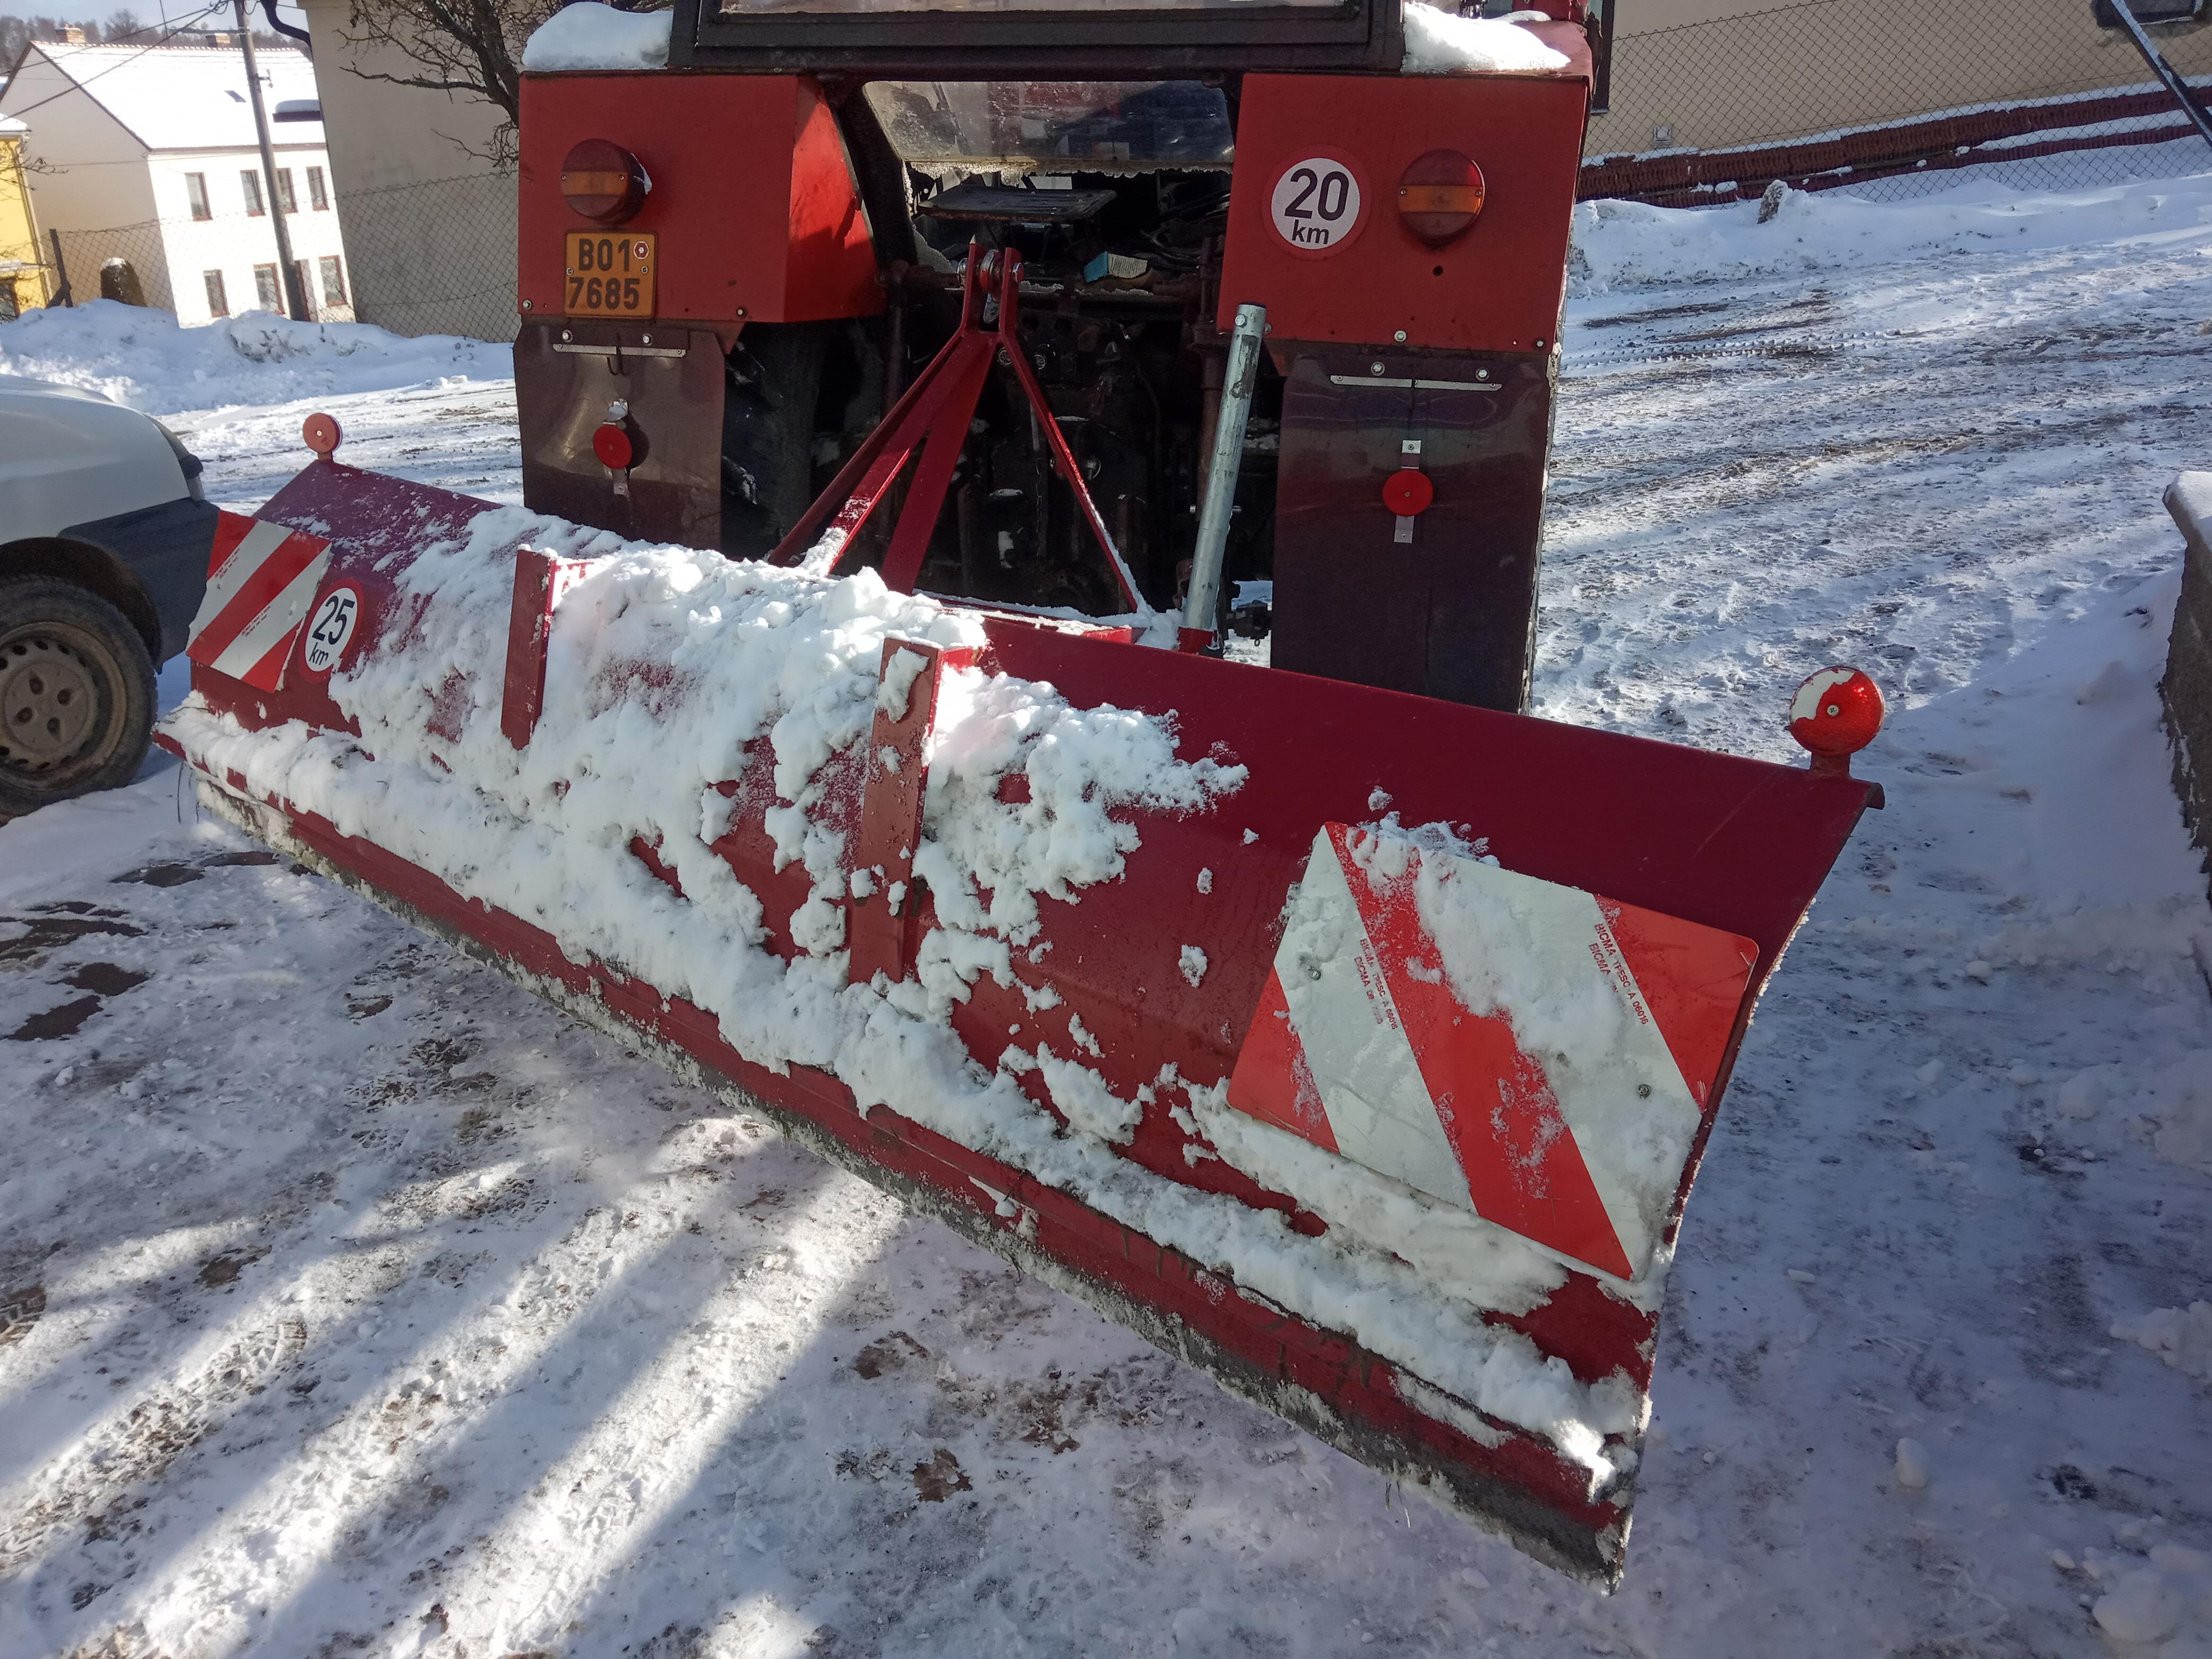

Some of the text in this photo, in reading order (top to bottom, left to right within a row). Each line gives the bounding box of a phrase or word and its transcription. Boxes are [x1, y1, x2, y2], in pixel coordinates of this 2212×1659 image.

[1284, 168, 1349, 222] 20
[1291, 219, 1329, 245] km
[578, 238, 630, 272] B01
[568, 276, 641, 310] 7685
[311, 595, 356, 645] 25
[308, 641, 329, 666] km
[1594, 923, 1616, 956] BICMA
[1632, 1001, 1648, 1025] 06016
